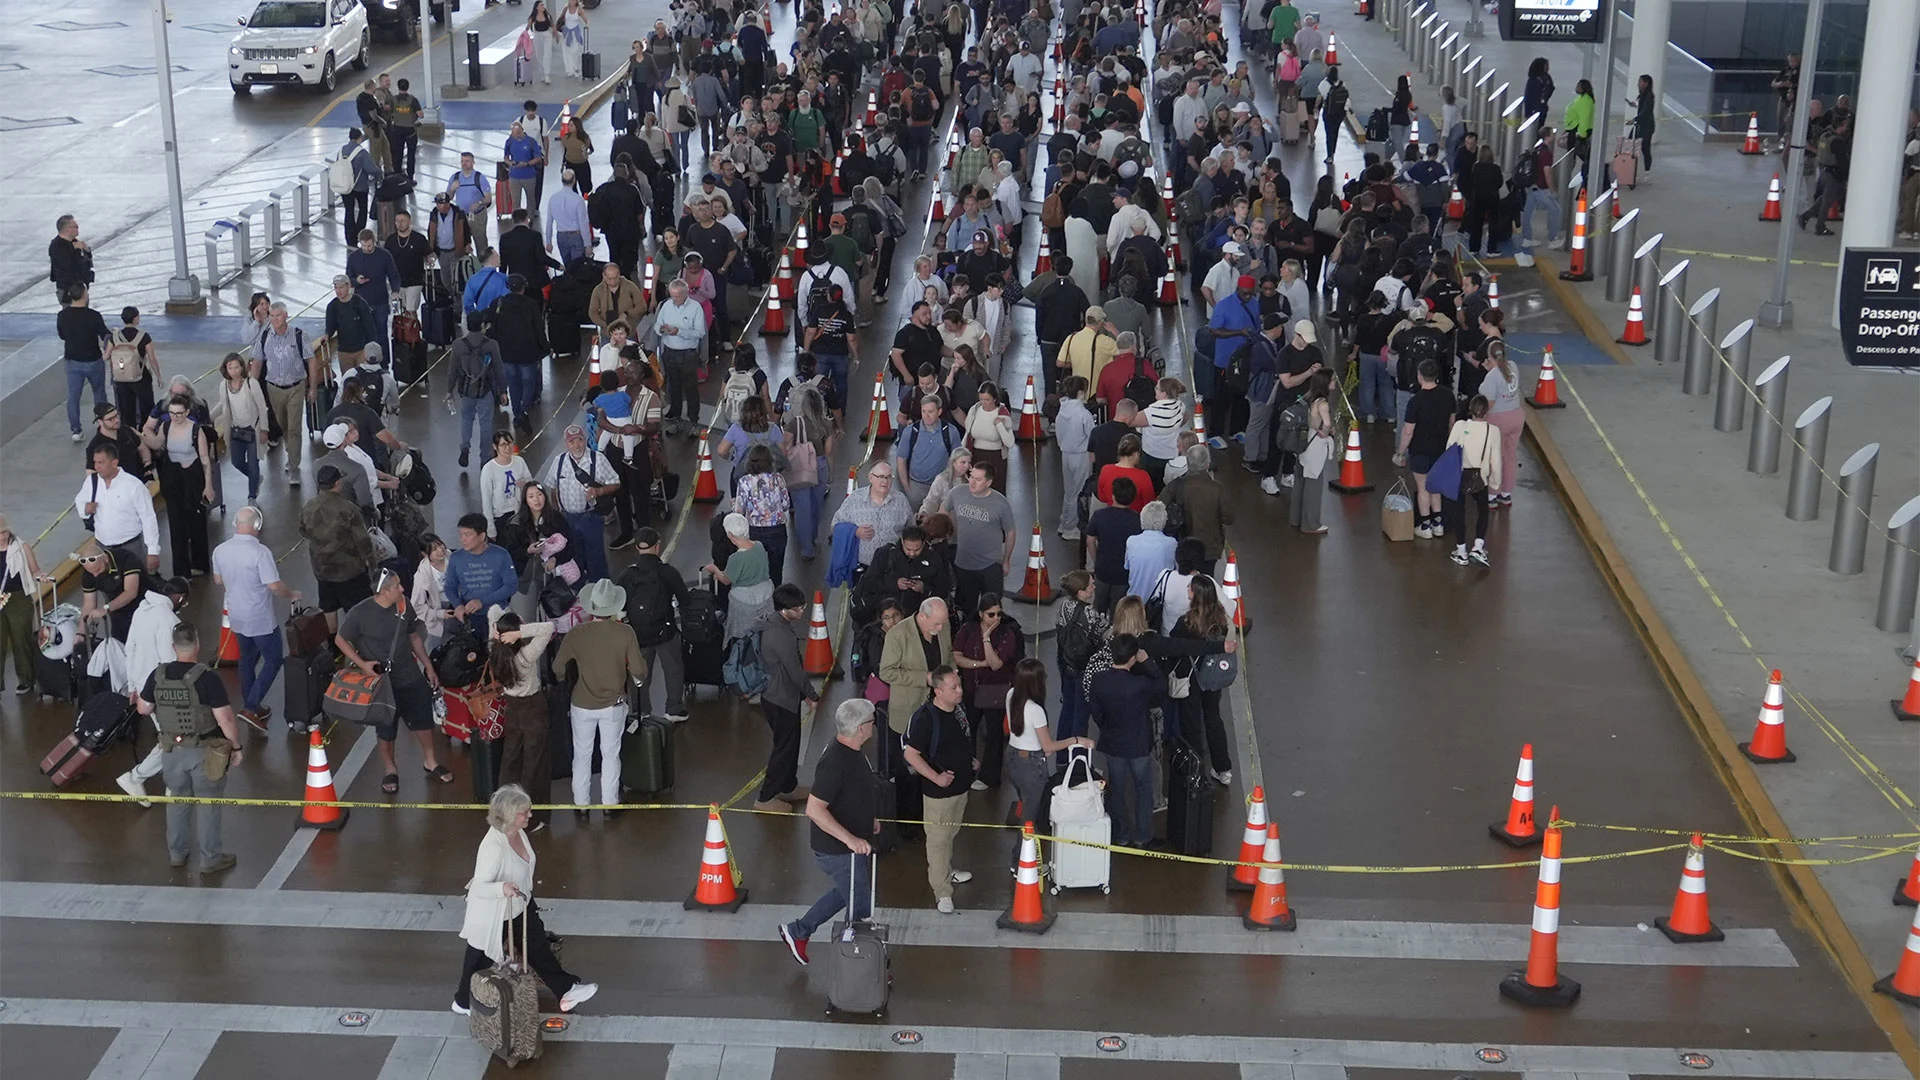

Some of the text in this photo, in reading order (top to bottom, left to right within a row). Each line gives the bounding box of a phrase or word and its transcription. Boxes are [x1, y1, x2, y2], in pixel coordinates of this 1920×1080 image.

[1519, 13, 1580, 22] AIR NEW ZEALAND
[1531, 23, 1576, 35] ZIPAIR
[1858, 323, 1920, 338] Drop-Off
[1856, 345, 1896, 354] Descenso
[1897, 346, 1908, 354] de
[157, 690, 189, 700] POLICE
[701, 873, 723, 884] PPM
